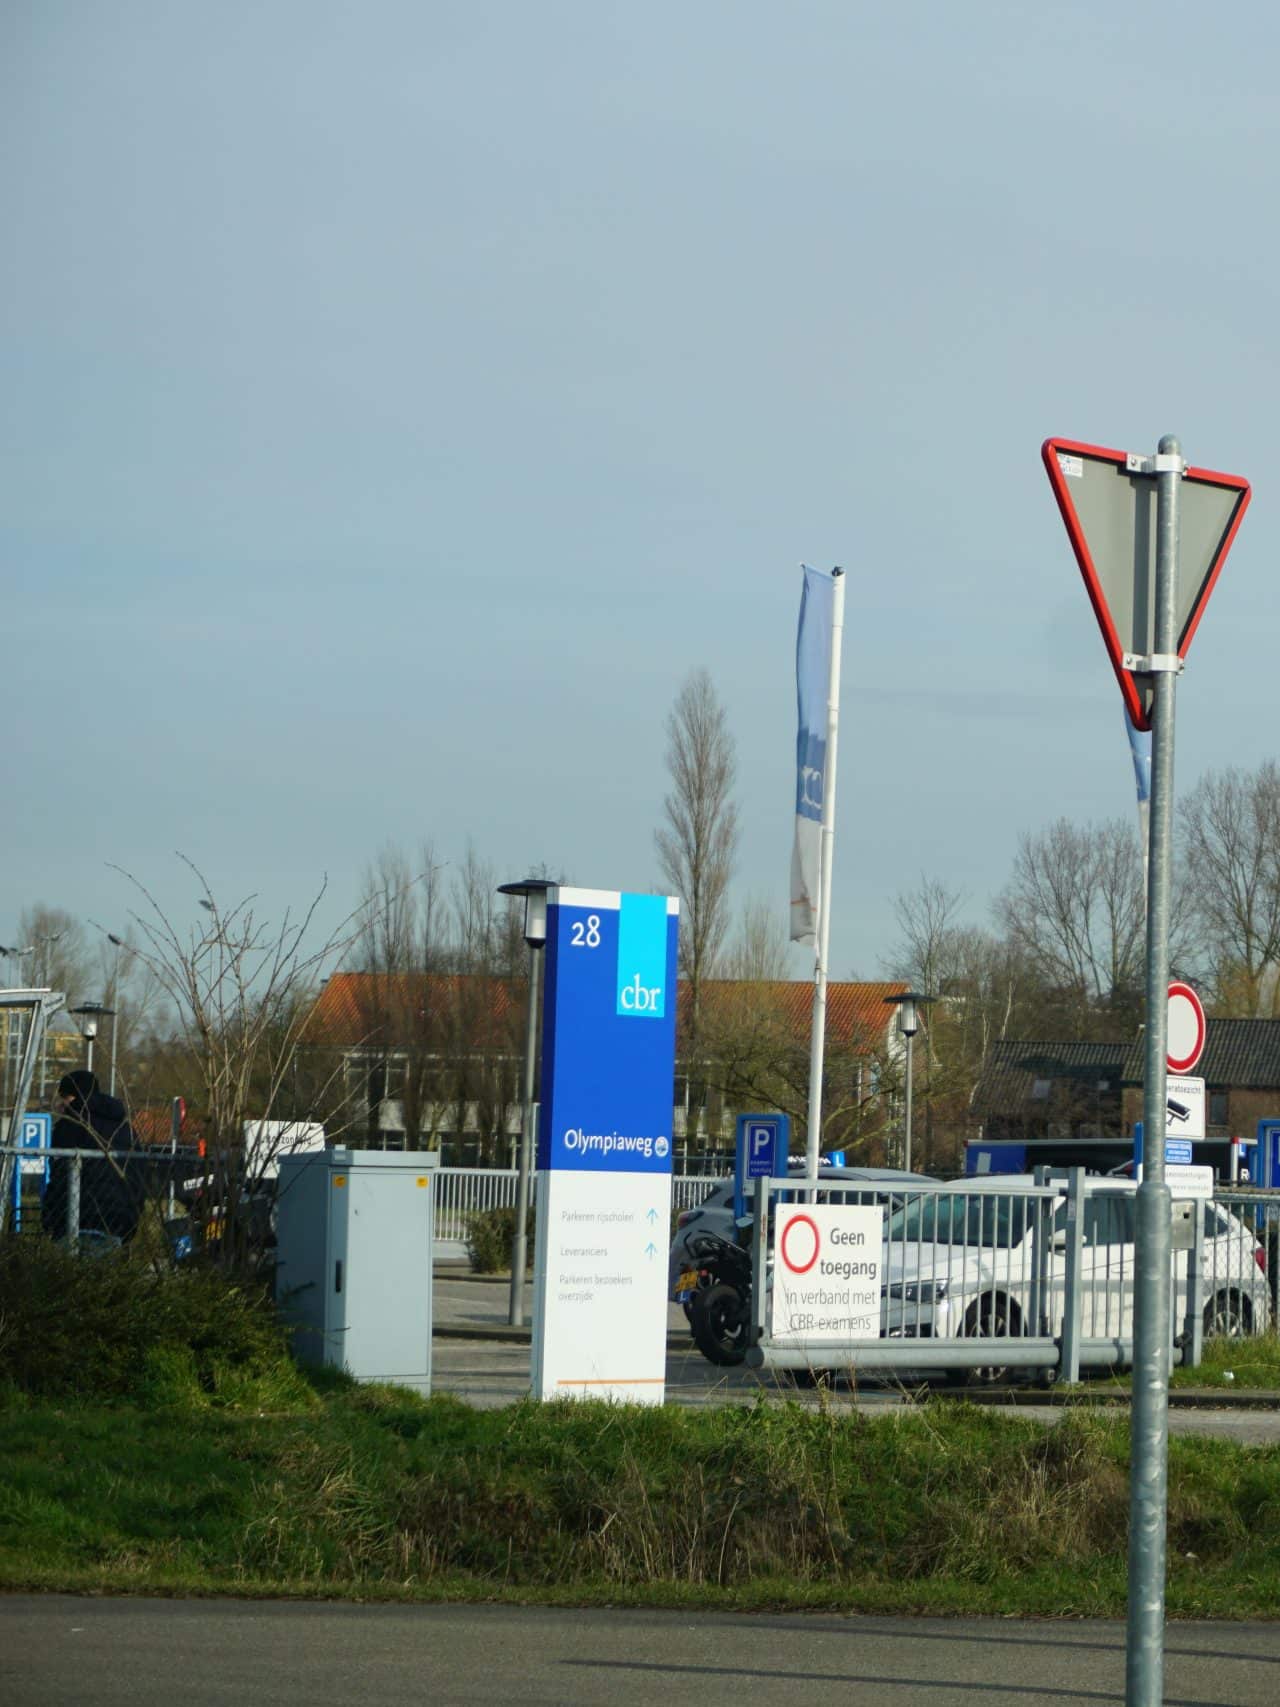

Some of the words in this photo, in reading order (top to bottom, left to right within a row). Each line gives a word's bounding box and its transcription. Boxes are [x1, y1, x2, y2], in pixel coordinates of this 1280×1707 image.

[571, 915, 601, 948] 28
[621, 974, 661, 1011] cbr
[26, 1124, 37, 1145] P
[564, 1129, 652, 1157] Olympiaweg
[754, 1129, 770, 1156] P
[836, 1153, 844, 1167] L
[562, 1211, 595, 1223] Parkeren
[830, 1228, 866, 1246] Geen
[820, 1259, 878, 1281] toegang
[559, 1274, 594, 1286] Parkeren
[786, 1289, 798, 1305] in
[801, 1288, 850, 1305] verband
[853, 1291, 877, 1306] met
[790, 1313, 872, 1331] CBR-examens
